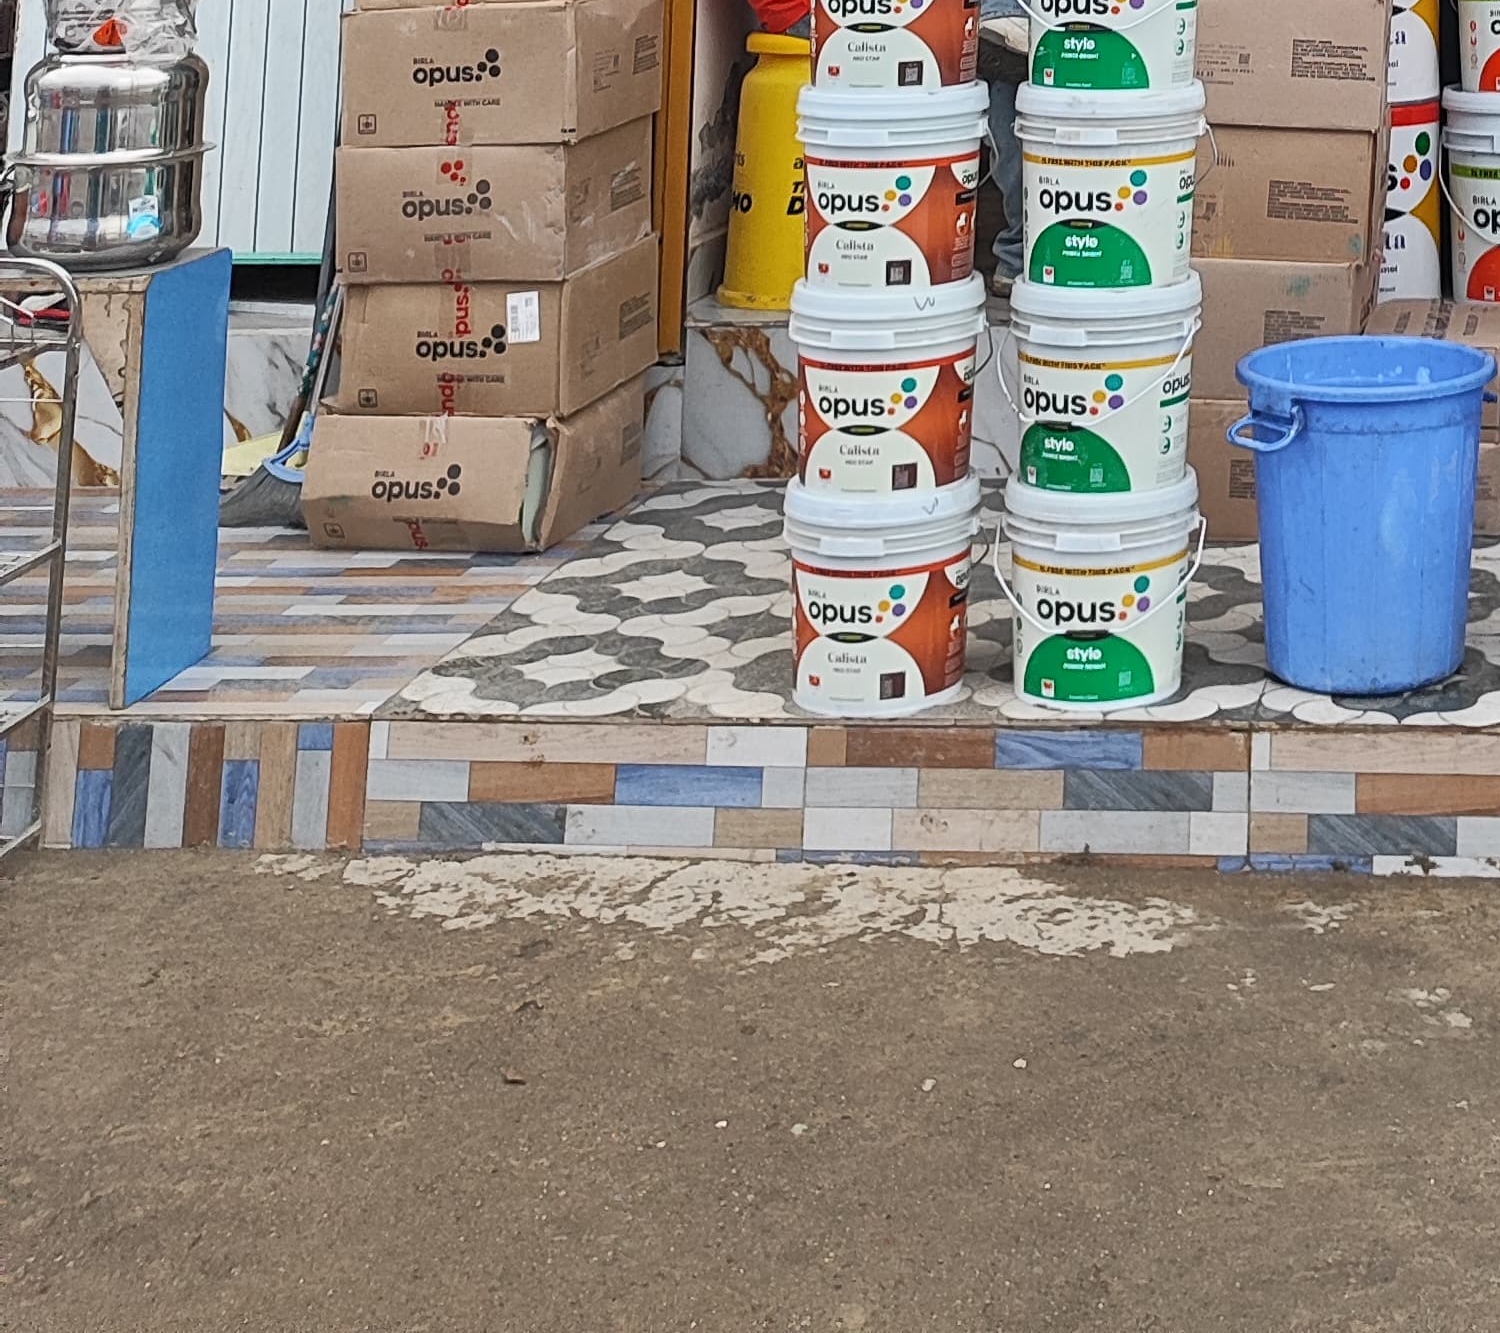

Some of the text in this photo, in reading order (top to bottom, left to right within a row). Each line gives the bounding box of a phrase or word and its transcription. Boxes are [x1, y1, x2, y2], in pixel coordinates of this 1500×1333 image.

[848, 41, 886, 53] Calista
[818, 192, 880, 215] opus
[1039, 188, 1112, 215] opus
[1472, 195, 1497, 206] BIRLA
[836, 239, 874, 251] Calista
[1162, 372, 1190, 395] opus
[819, 395, 886, 419] opus
[1024, 387, 1087, 416] opus
[839, 444, 880, 456] Calista
[808, 600, 872, 625] opus
[1036, 598, 1116, 626] opus
